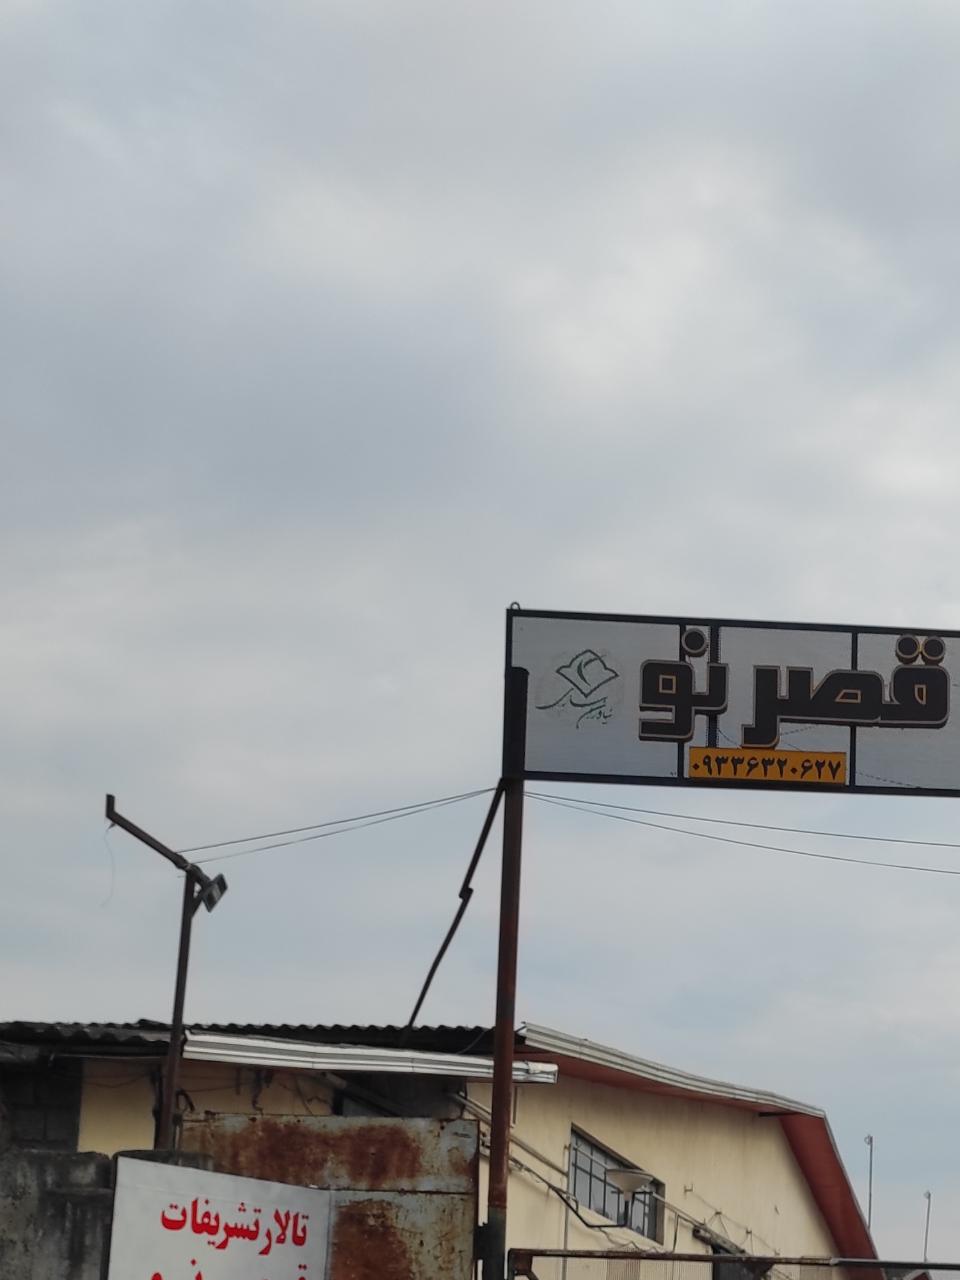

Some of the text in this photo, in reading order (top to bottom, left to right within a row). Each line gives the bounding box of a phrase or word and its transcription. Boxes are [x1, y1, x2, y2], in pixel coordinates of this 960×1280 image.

[638, 627, 730, 744] نو
[740, 633, 950, 750] قصر
[160, 1197, 310, 1256] تالار تشریفات
